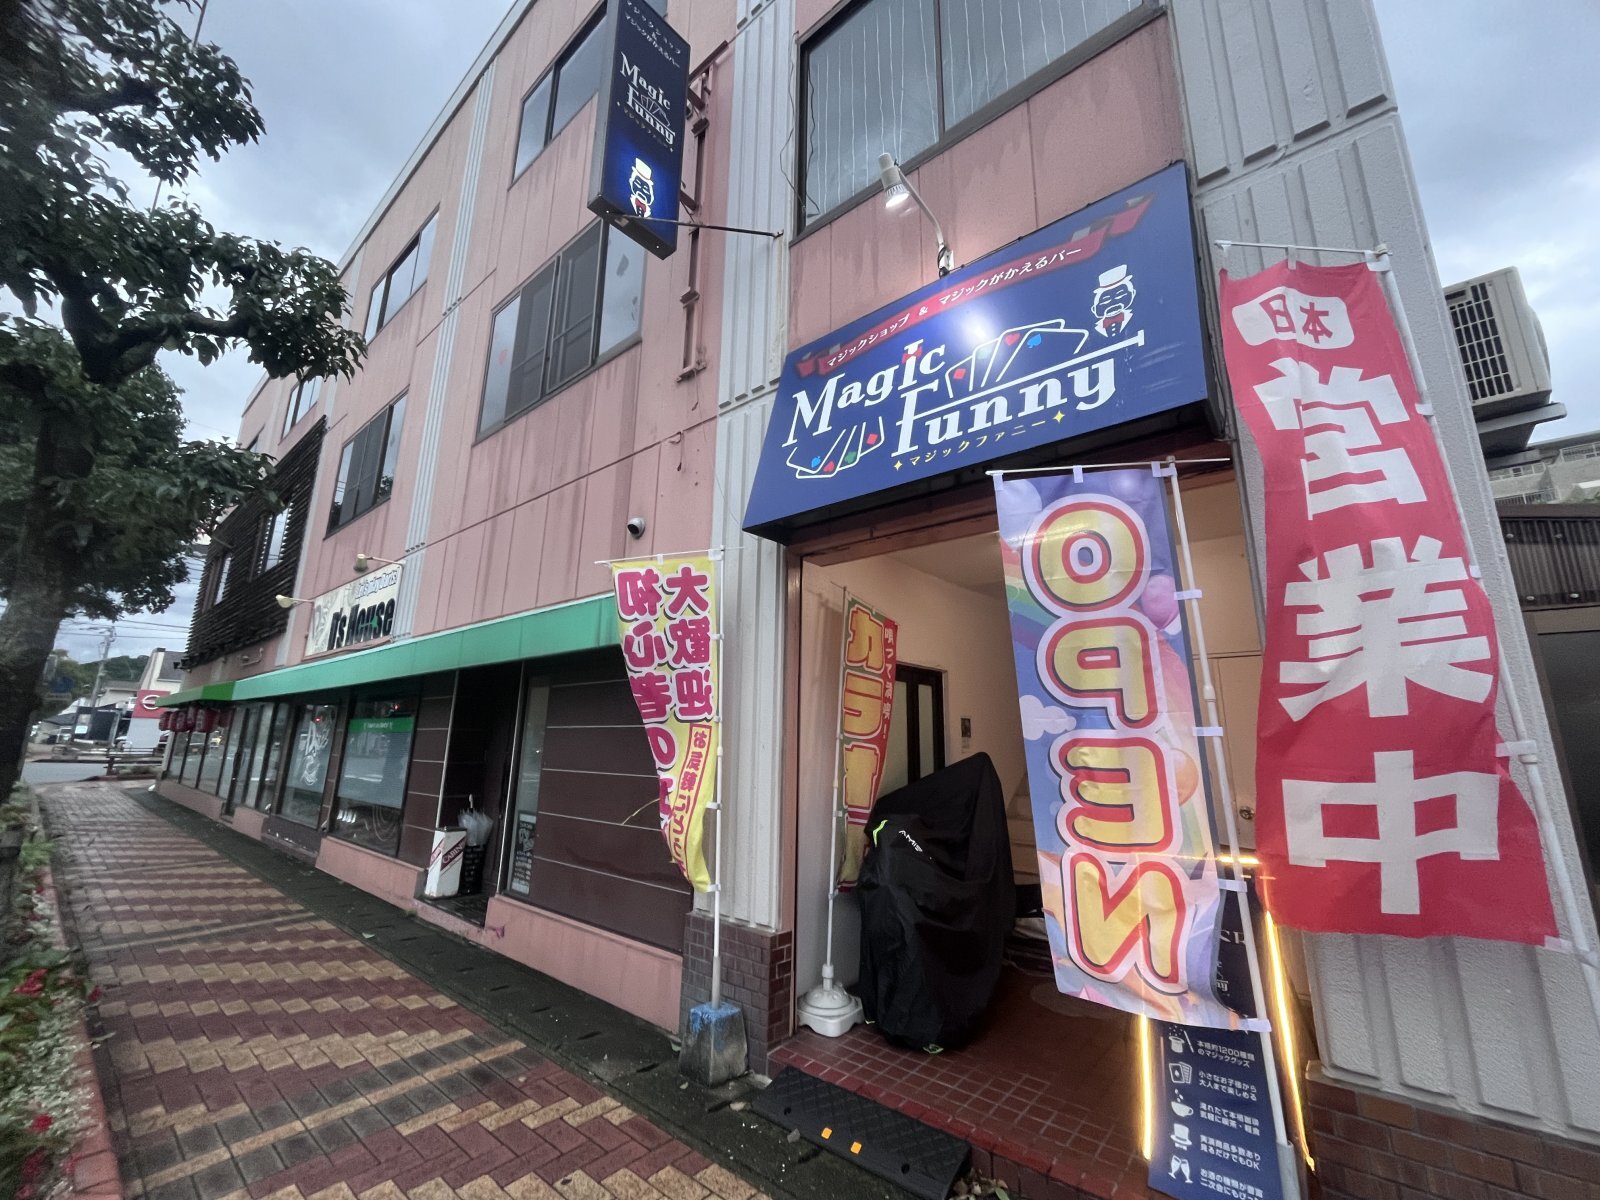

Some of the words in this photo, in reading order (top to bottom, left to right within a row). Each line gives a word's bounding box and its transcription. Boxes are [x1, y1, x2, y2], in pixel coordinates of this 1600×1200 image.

[620, 51, 671, 110] Magic
[626, 84, 676, 145] Funny
[827, 312, 910, 367] マジックショップ
[918, 306, 929, 316] &
[939, 248, 1082, 305] マジックがかえるバー
[782, 339, 946, 447] Magic
[891, 350, 1122, 457] Funny
[909, 420, 1046, 466] マジックファニー
